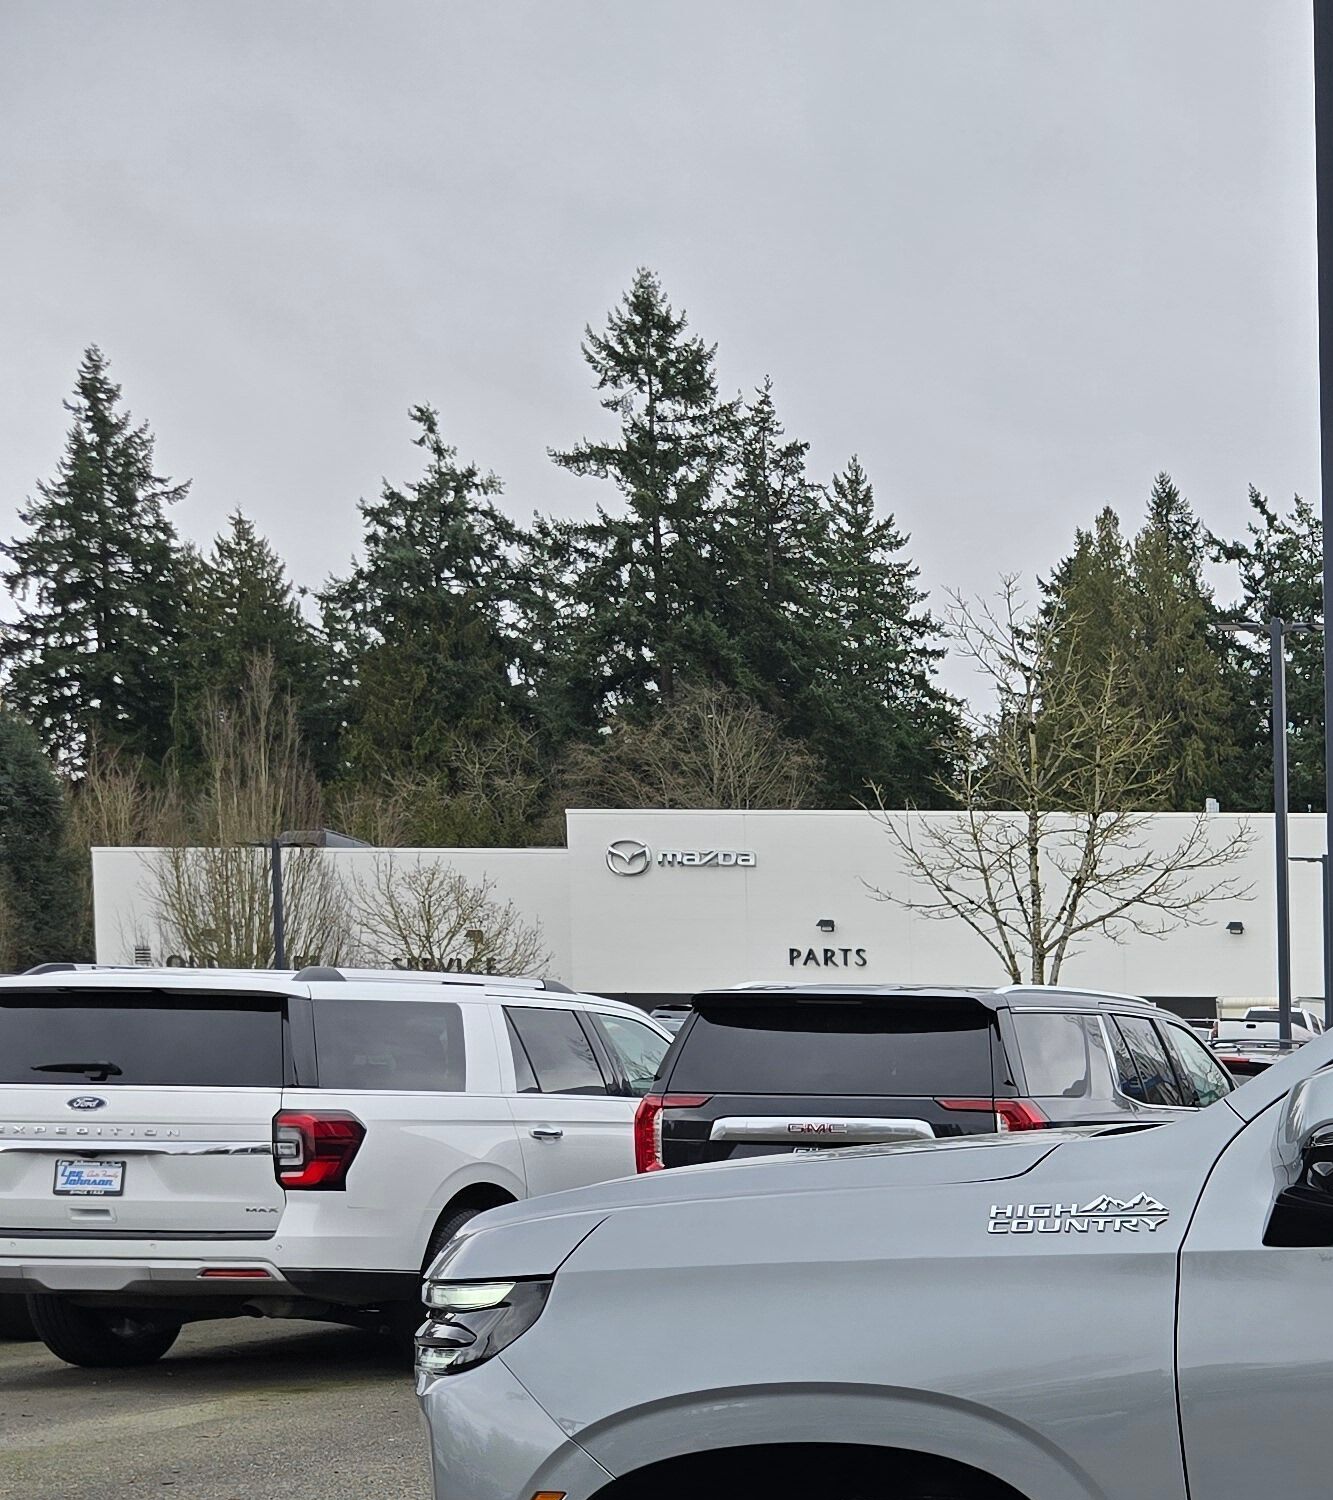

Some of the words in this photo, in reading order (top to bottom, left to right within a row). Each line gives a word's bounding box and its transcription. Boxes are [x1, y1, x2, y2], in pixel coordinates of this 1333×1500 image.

[656, 850, 757, 868] mazda
[788, 948, 868, 968] PARTS
[73, 1097, 100, 1110] Ford
[787, 1123, 848, 1134] GMC
[61, 1166, 84, 1178] Lee
[61, 1177, 114, 1187] Johnson
[245, 1206, 279, 1214] MAX
[989, 1203, 1078, 1218] HIGH
[987, 1217, 1168, 1234] COUNTRY
